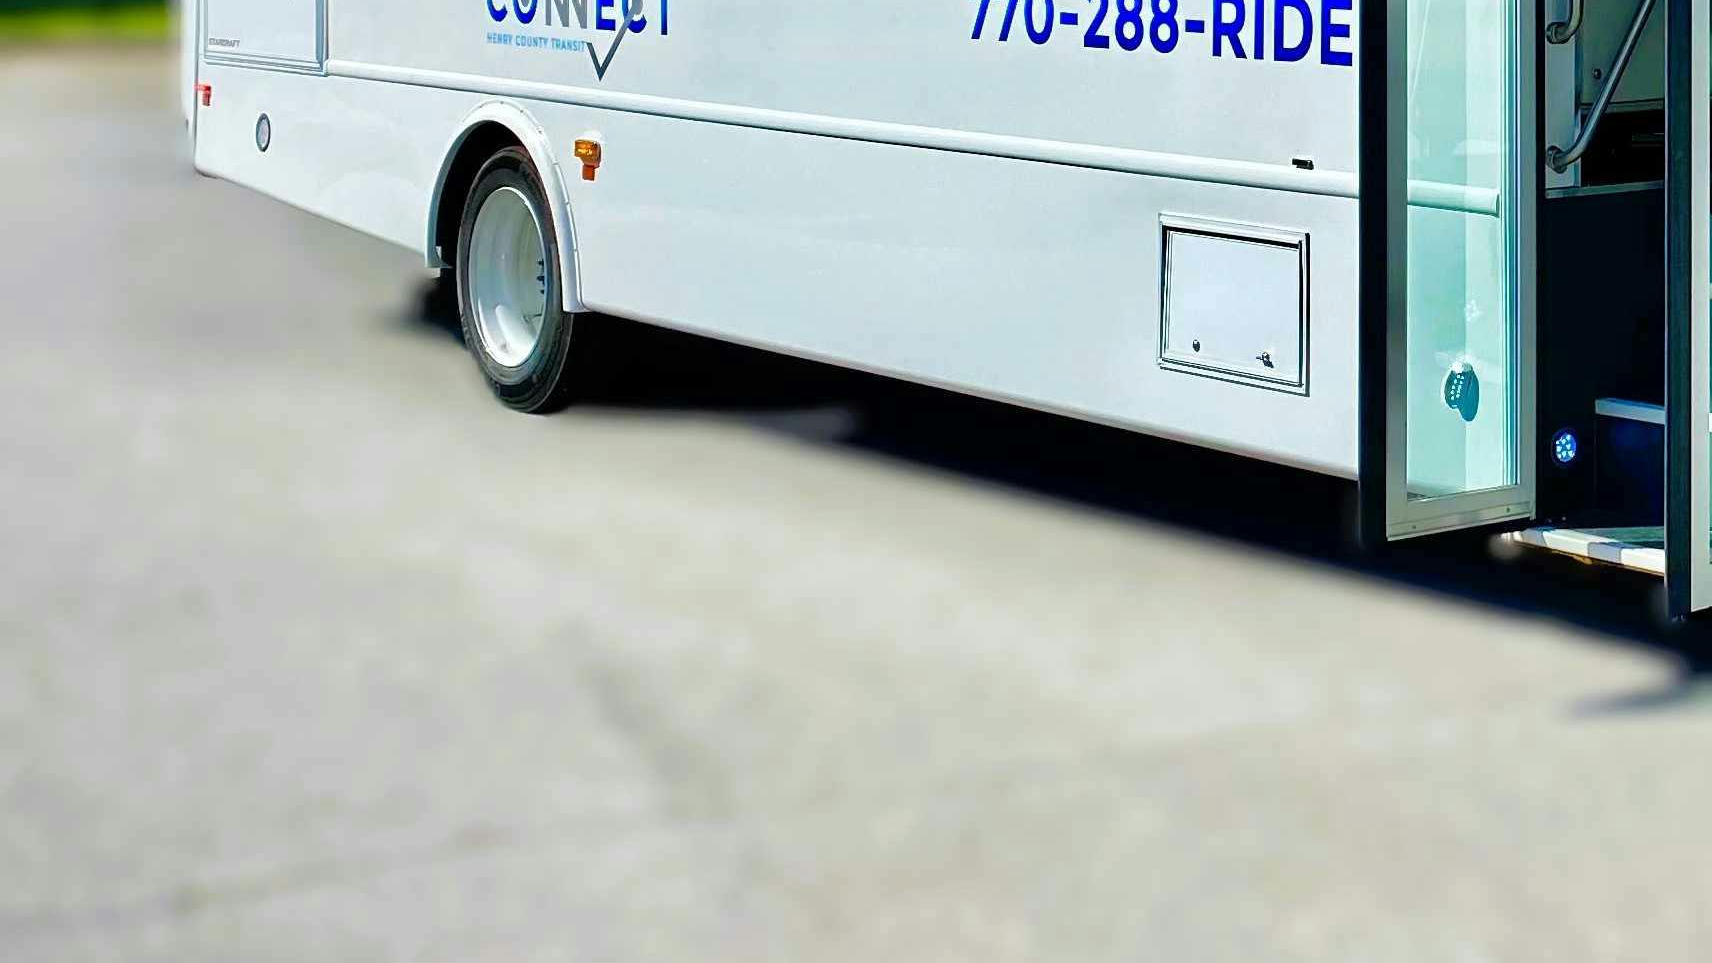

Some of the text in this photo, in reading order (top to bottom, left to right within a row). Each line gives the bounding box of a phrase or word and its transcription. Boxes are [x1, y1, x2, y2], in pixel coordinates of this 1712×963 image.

[487, 32, 586, 52] HENRY COUNTY TRANSIT
